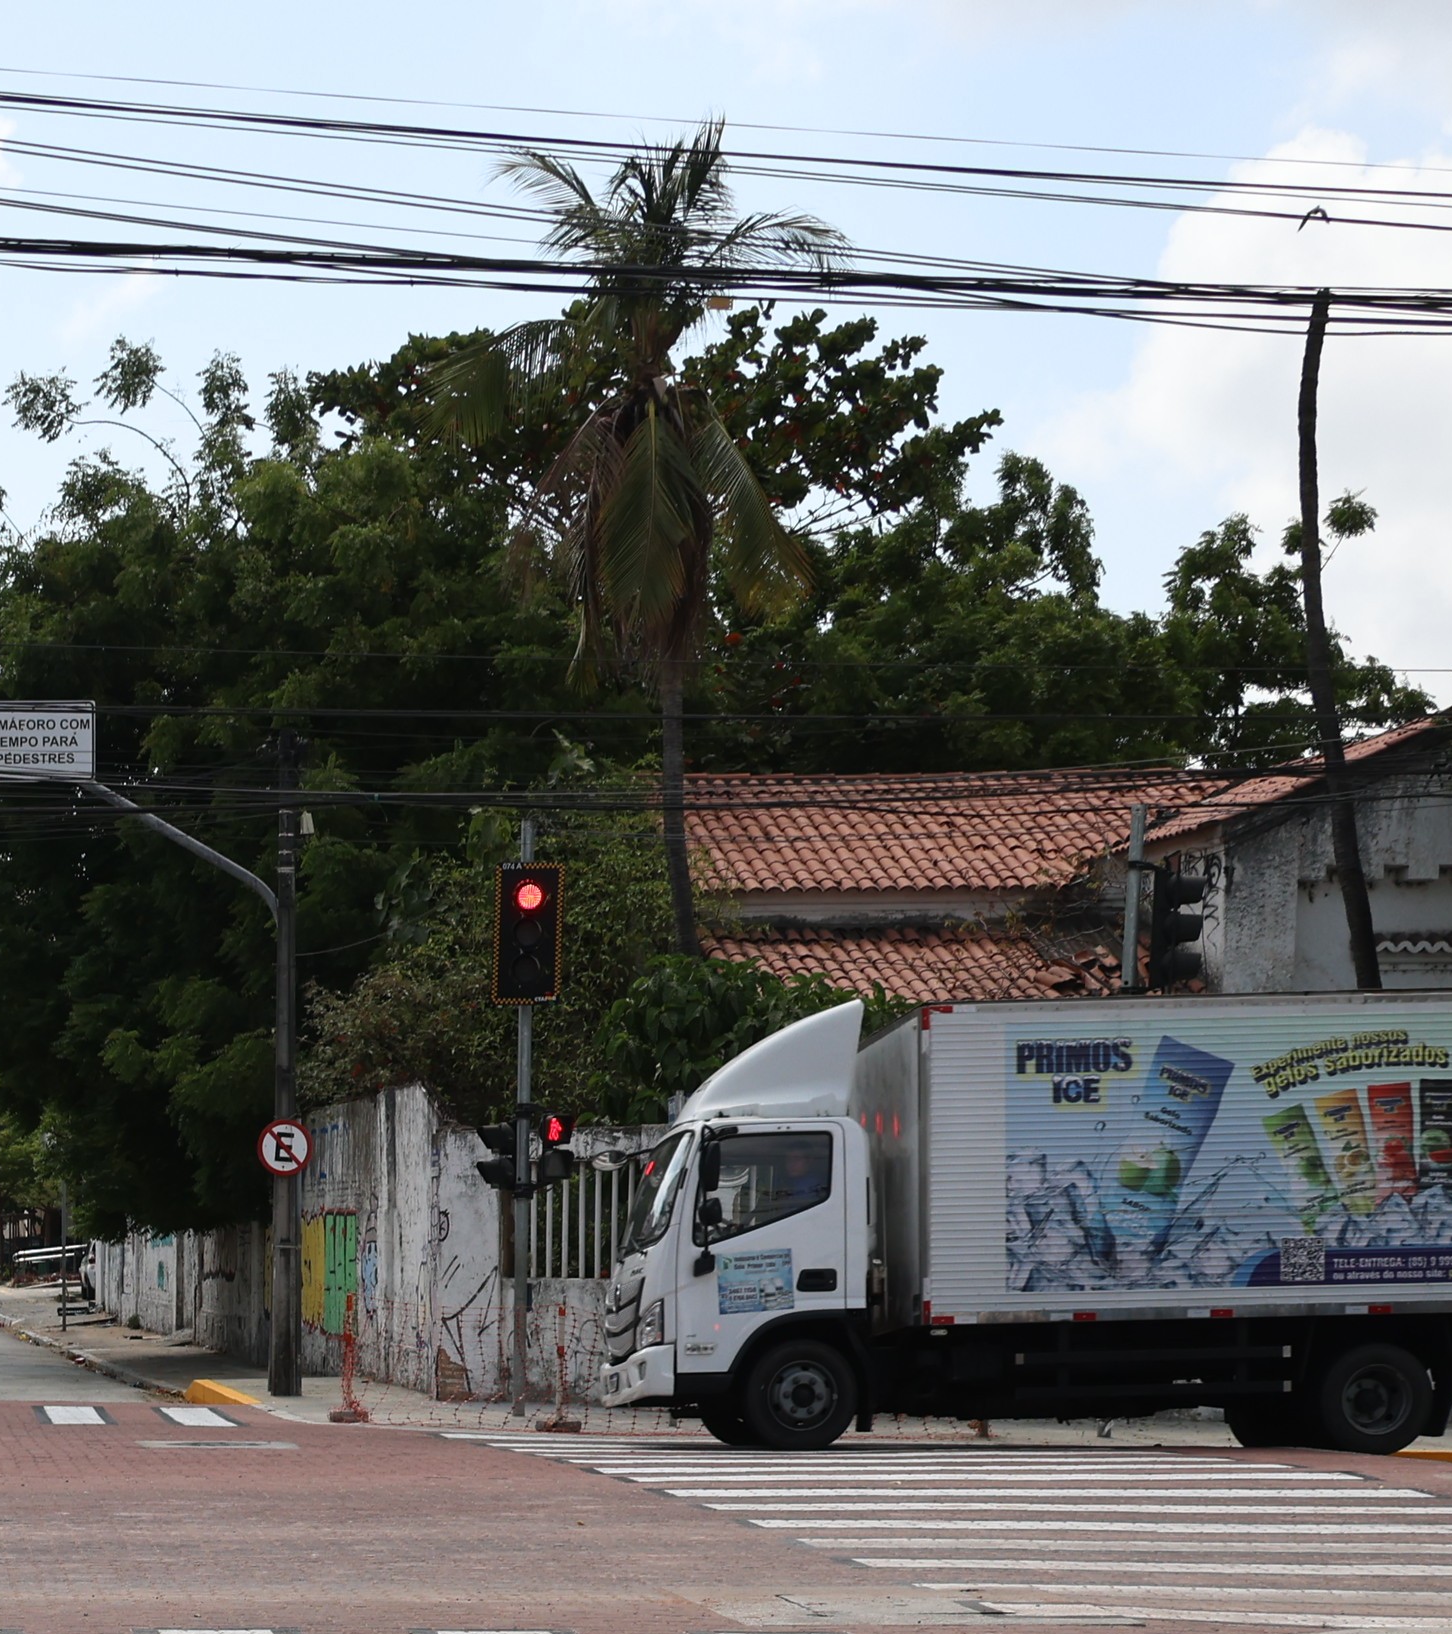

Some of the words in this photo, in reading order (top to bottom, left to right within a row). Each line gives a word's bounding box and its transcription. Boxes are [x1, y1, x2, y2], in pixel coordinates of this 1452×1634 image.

[60, 718, 90, 731] COM
[1016, 1037, 1133, 1074] PRIMOS
[1252, 1034, 1346, 1081] Experimente
[1352, 1028, 1408, 1050] nossos
[1262, 1060, 1319, 1099] gelos
[1325, 1043, 1449, 1072] saborizados
[1052, 1074, 1101, 1104] ICE
[1144, 1111, 1193, 1136] Saborizado
[274, 1131, 295, 1162] E
[1333, 1257, 1405, 1268] TELE-ENTREGA:
[1408, 1256, 1427, 1268] (85)
[1430, 1256, 1437, 1266] 9
[1333, 1271, 1344, 1280] ou
[1346, 1269, 1380, 1279] através
[1382, 1268, 1394, 1279] do
[1396, 1269, 1424, 1278] nosso
[1426, 1267, 1446, 1278] site:
